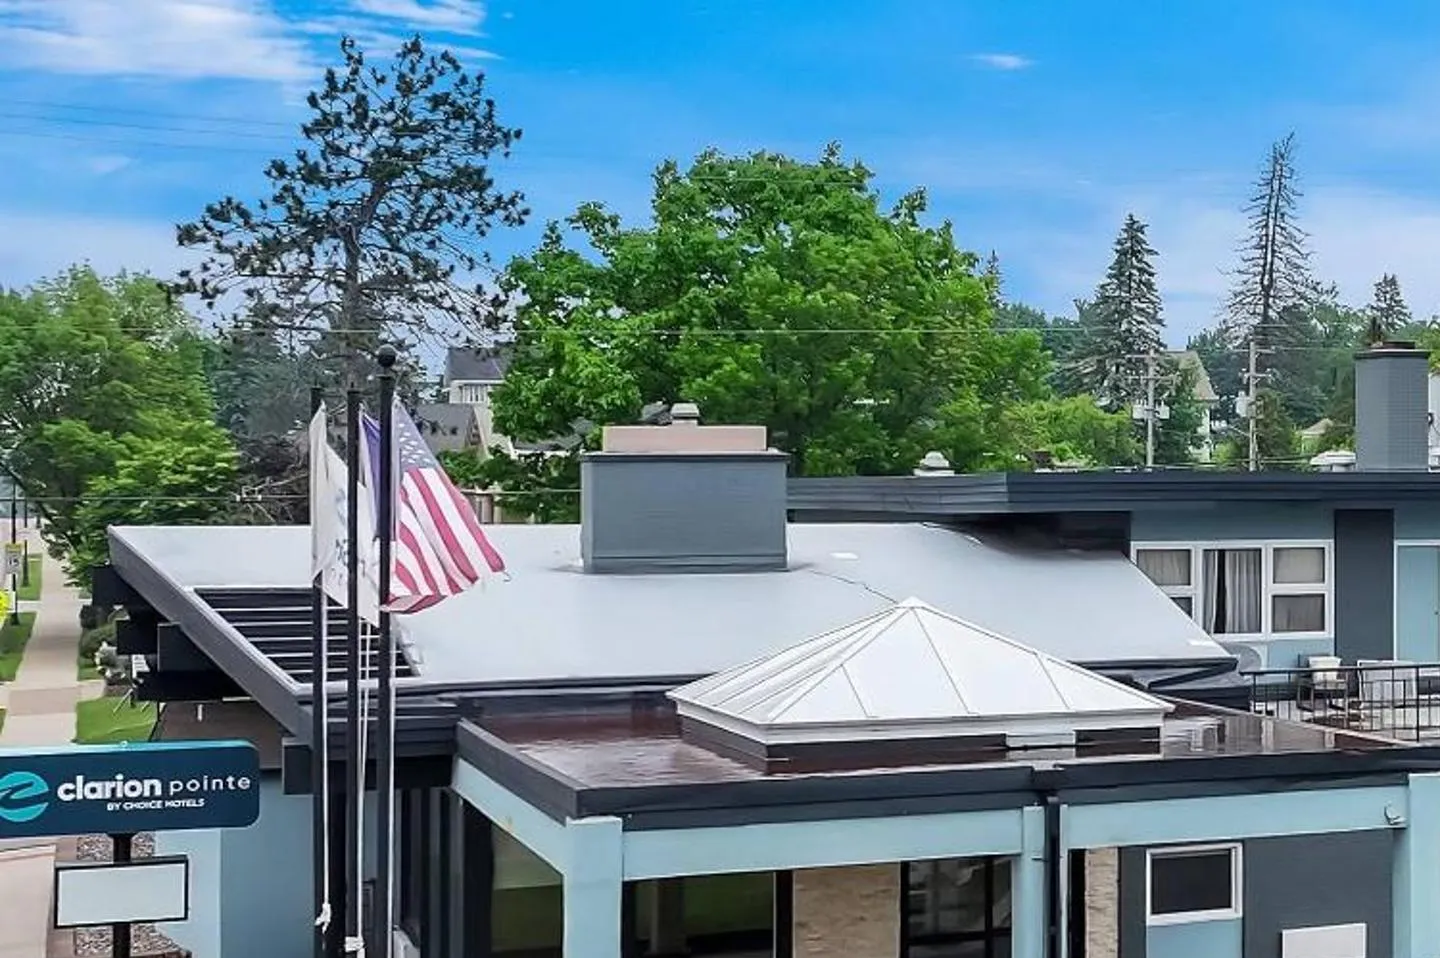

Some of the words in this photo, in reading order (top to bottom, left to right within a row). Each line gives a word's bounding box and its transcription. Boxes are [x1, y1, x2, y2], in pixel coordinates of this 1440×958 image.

[57, 773, 162, 801] clarion
[169, 775, 251, 796] pointe
[107, 802, 121, 811] BY
[123, 800, 162, 811] CHOICE
[165, 798, 205, 808] HOTELS
